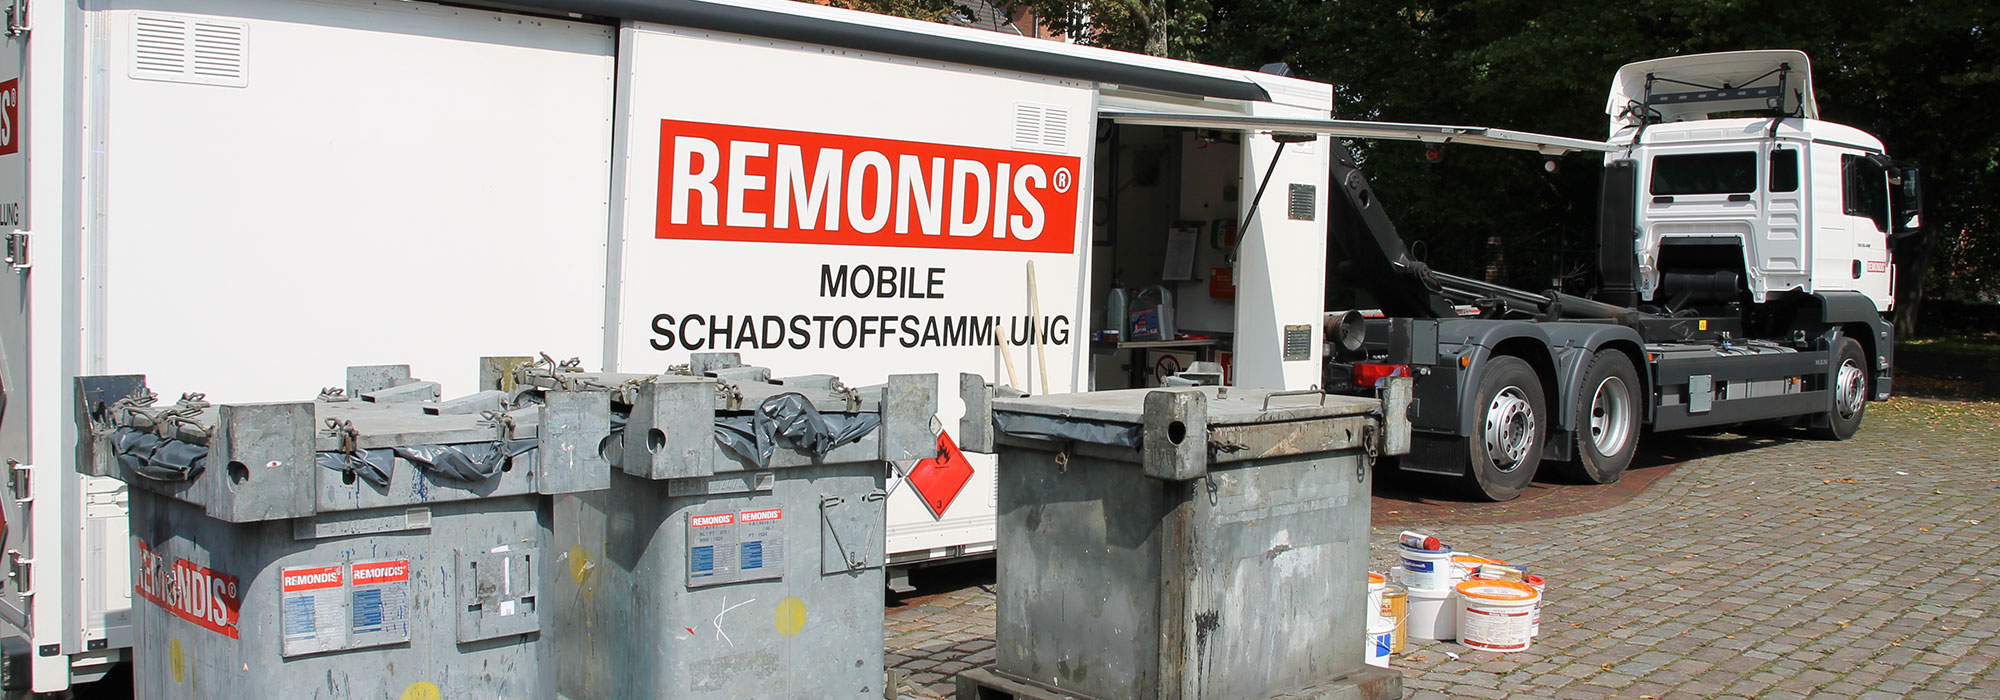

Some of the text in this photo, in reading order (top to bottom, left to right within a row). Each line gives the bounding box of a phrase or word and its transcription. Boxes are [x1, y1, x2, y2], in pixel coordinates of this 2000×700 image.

[819, 263, 946, 299] MOBILE
[649, 312, 1070, 351] SCHADSTOFFSAMMLUNG
[936, 499, 943, 509] 3
